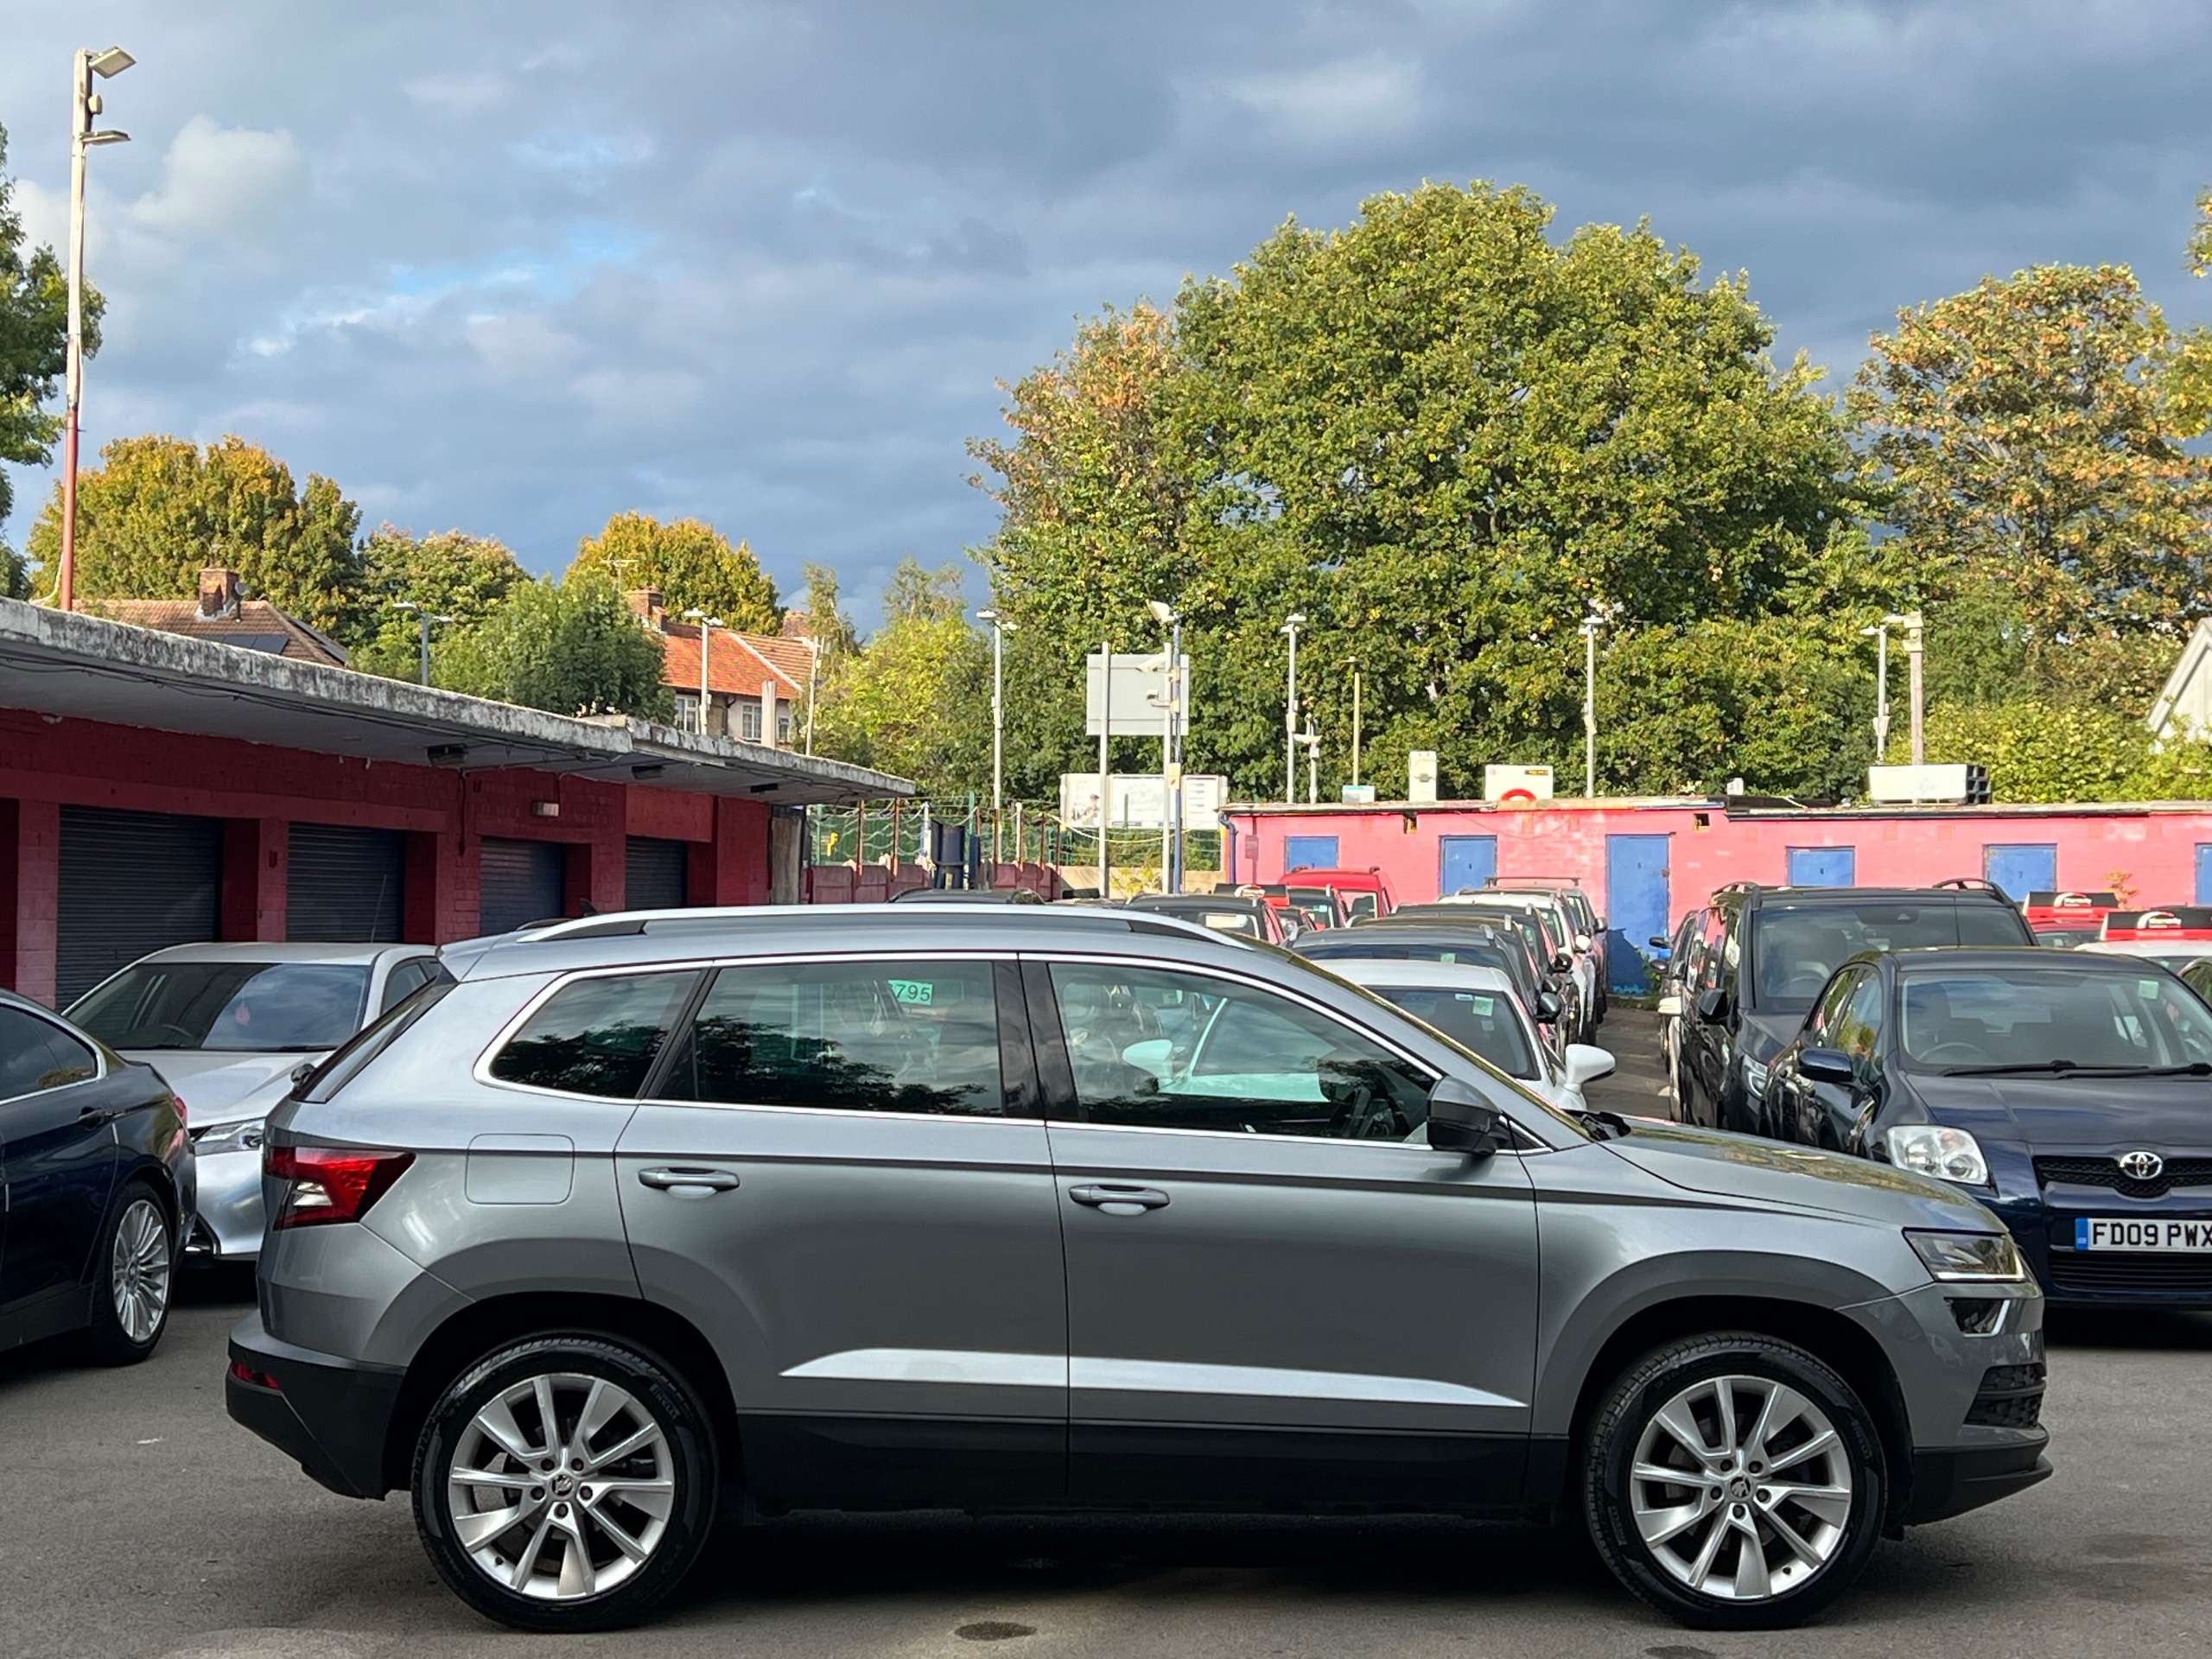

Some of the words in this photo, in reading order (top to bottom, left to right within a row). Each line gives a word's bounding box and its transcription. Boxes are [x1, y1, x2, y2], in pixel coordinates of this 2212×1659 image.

[888, 983, 931, 1002] 795
[2093, 1222, 2158, 1246] FD09
[2167, 1224, 2212, 1248] PWX
